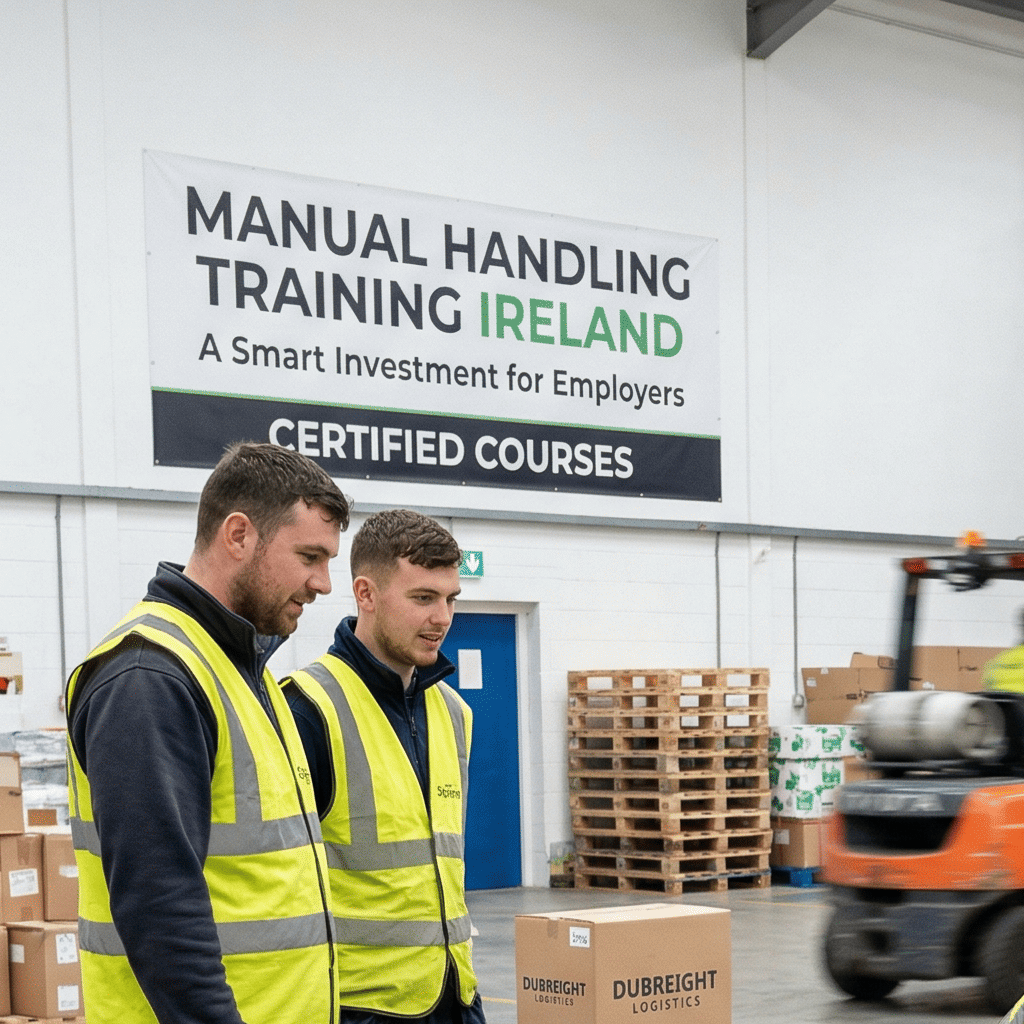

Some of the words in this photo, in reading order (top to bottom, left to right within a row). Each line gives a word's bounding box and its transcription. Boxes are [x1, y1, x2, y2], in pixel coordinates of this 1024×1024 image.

[187, 186, 427, 266] MANUAL
[444, 224, 690, 300] HANDLING
[196, 255, 461, 333] TRAINING
[481, 292, 683, 357] IRELAND
[198, 333, 222, 362] A
[232, 336, 325, 372] Smart
[336, 347, 498, 389] Investment
[507, 363, 543, 393] for
[554, 370, 684, 410] Employers
[269, 418, 465, 466] CERTIFIED
[475, 435, 633, 478] COURSES
[523, 976, 586, 996] DUBREIGHT
[613, 970, 717, 1000] DUBREIGHT
[633, 995, 700, 1014] LOGISTICS
